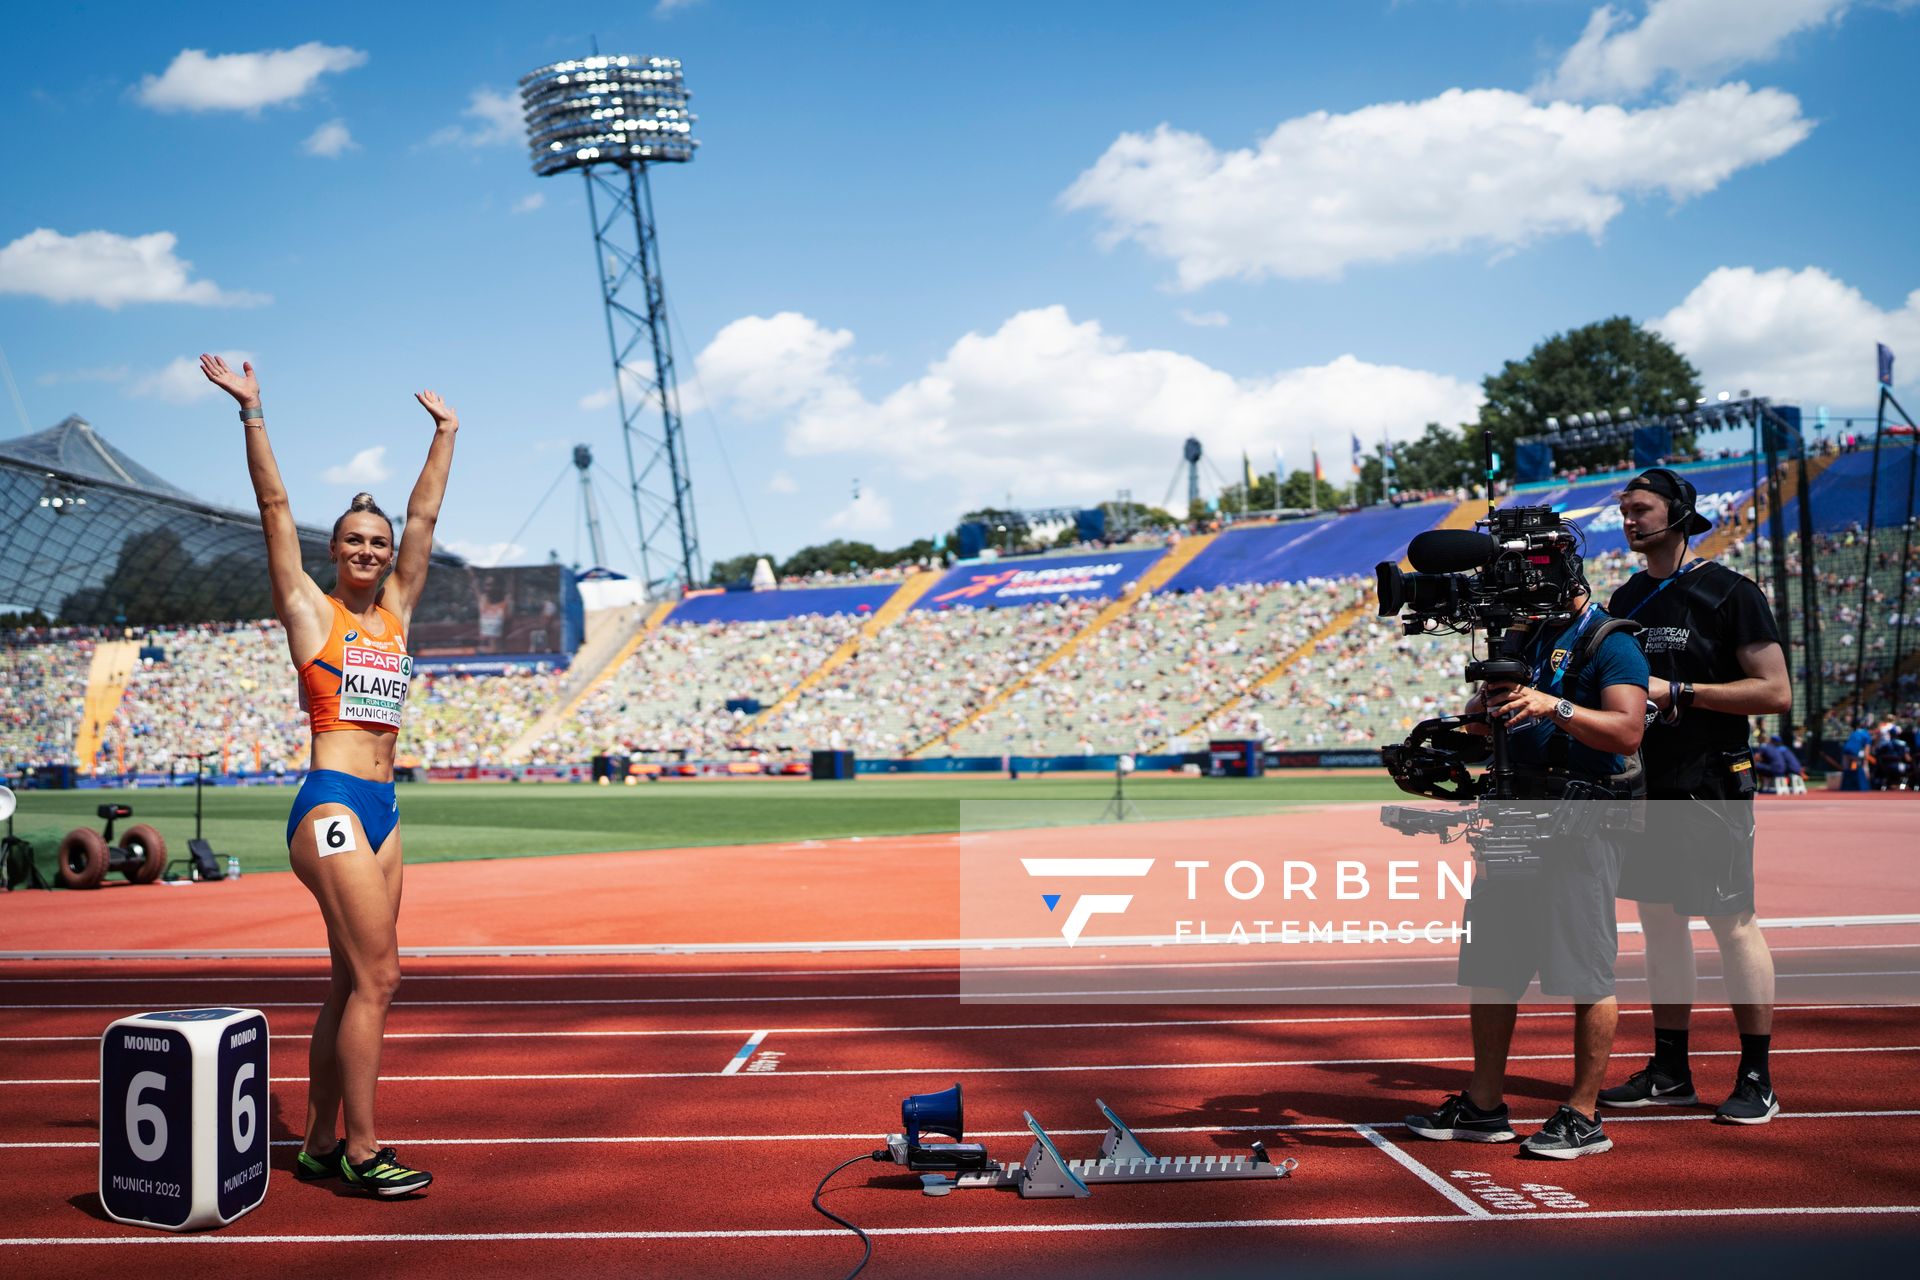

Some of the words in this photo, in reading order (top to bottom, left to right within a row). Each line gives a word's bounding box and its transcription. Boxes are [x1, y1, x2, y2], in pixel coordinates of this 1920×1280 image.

[1647, 636, 1687, 644] CHAMPIONSHIPS
[1648, 627, 1690, 638] EUROPEAN
[1645, 642, 1667, 650] MUNICH
[1668, 642, 1685, 651] 2022
[347, 650, 398, 670] SPAR
[344, 674, 408, 702] KLAVER
[345, 707, 387, 720] MUNICH
[365, 698, 380, 707] RUN
[326, 821, 346, 848] 6
[124, 1035, 170, 1052] MONDO
[230, 1027, 256, 1049] MONDO
[125, 1071, 168, 1162] 6
[231, 1062, 256, 1154] 6
[112, 1175, 152, 1194] MUNICH
[155, 1182, 181, 1198] 2022
[224, 1169, 248, 1194] MUNICH
[248, 1161, 262, 1179] 2022
[1520, 1183, 1590, 1209] 400
